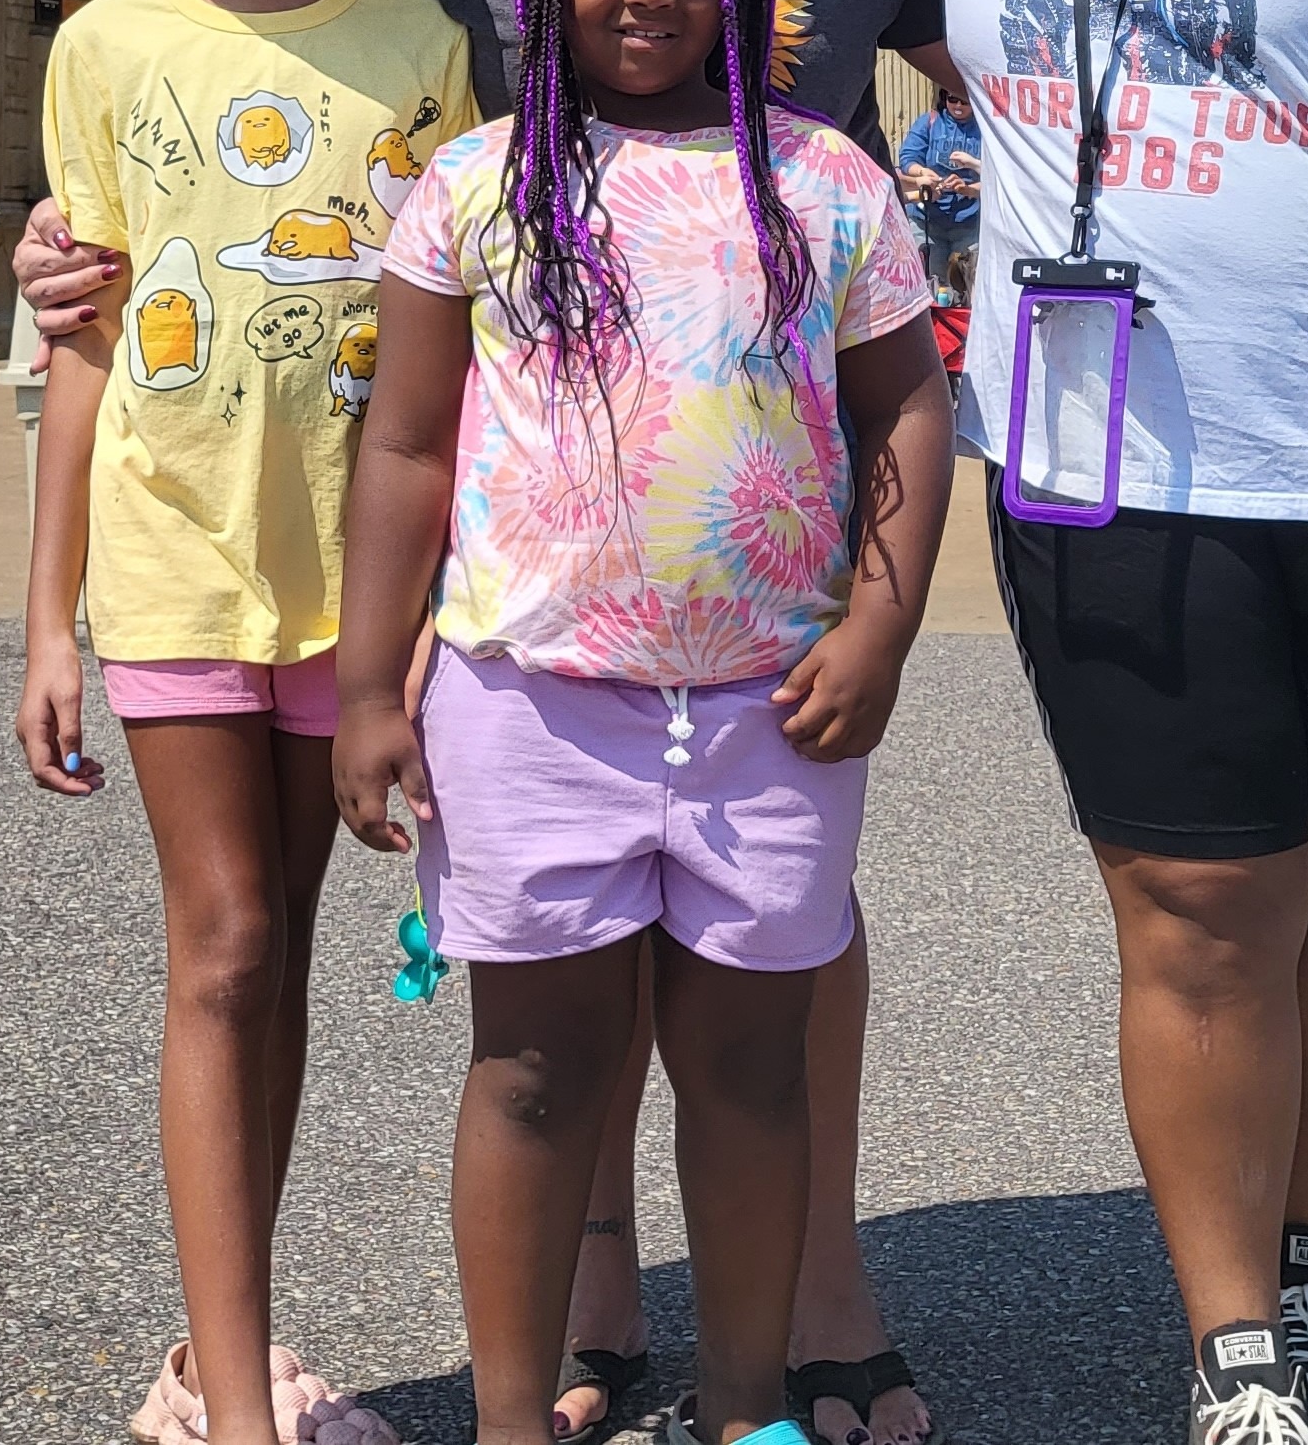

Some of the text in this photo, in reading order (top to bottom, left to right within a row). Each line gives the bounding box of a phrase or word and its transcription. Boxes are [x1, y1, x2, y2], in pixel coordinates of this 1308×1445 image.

[981, 73, 1151, 131] WORD
[320, 91, 332, 152] huh?
[342, 300, 379, 317] short
[255, 304, 310, 339] let me
[282, 328, 302, 348] go
[1224, 1335, 1263, 1346] CONVERSE
[1226, 1345, 1266, 1362] ALL STAR
